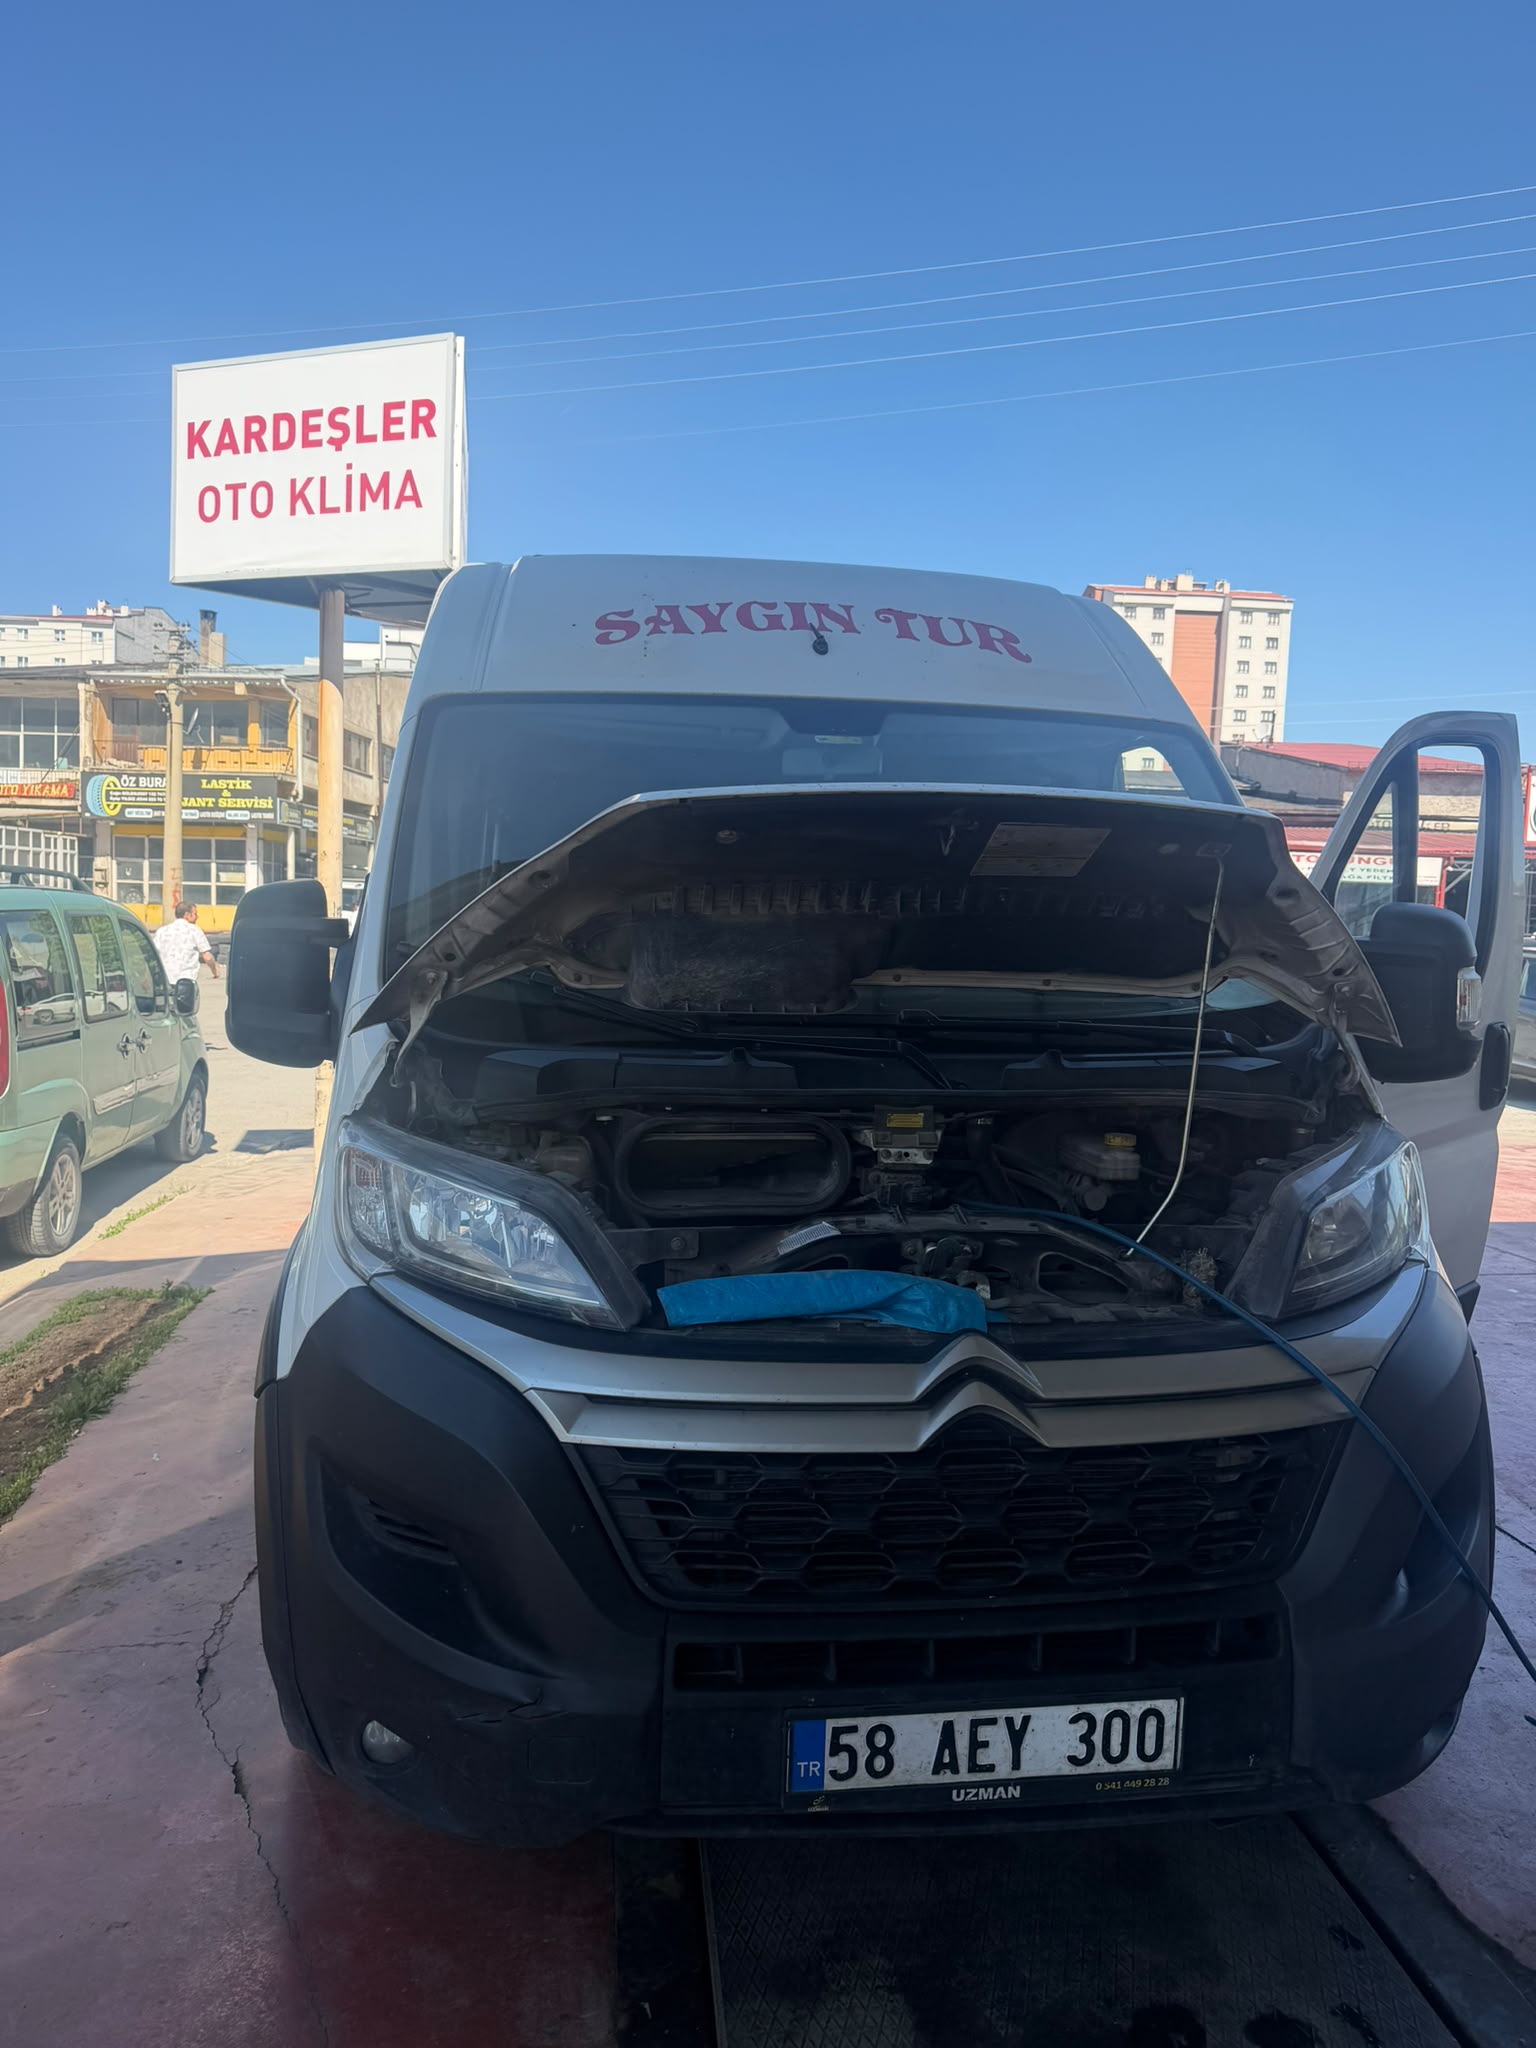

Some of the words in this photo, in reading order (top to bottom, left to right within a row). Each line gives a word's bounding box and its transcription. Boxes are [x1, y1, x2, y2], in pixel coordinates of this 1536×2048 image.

[187, 398, 437, 460] KARDEŞLER
[198, 480, 274, 523] OTO
[289, 462, 423, 517] KLİMA
[594, 600, 861, 645] SAYGIN
[874, 608, 1033, 664] TUR
[120, 774, 137, 787] ÖZ
[200, 777, 252, 790] LASTİK
[22, 784, 69, 798] YIKAMA
[181, 797, 215, 808] JANT
[217, 795, 274, 809] SERVİSİ
[828, 1722, 896, 1782] 58
[931, 1714, 1032, 1776] AEY
[1066, 1707, 1165, 1767] 300
[796, 1760, 821, 1778] TR
[1143, 1778, 1156, 1787] 28
[1157, 1777, 1170, 1786] 28
[952, 1785, 1021, 1802] UZMAN
